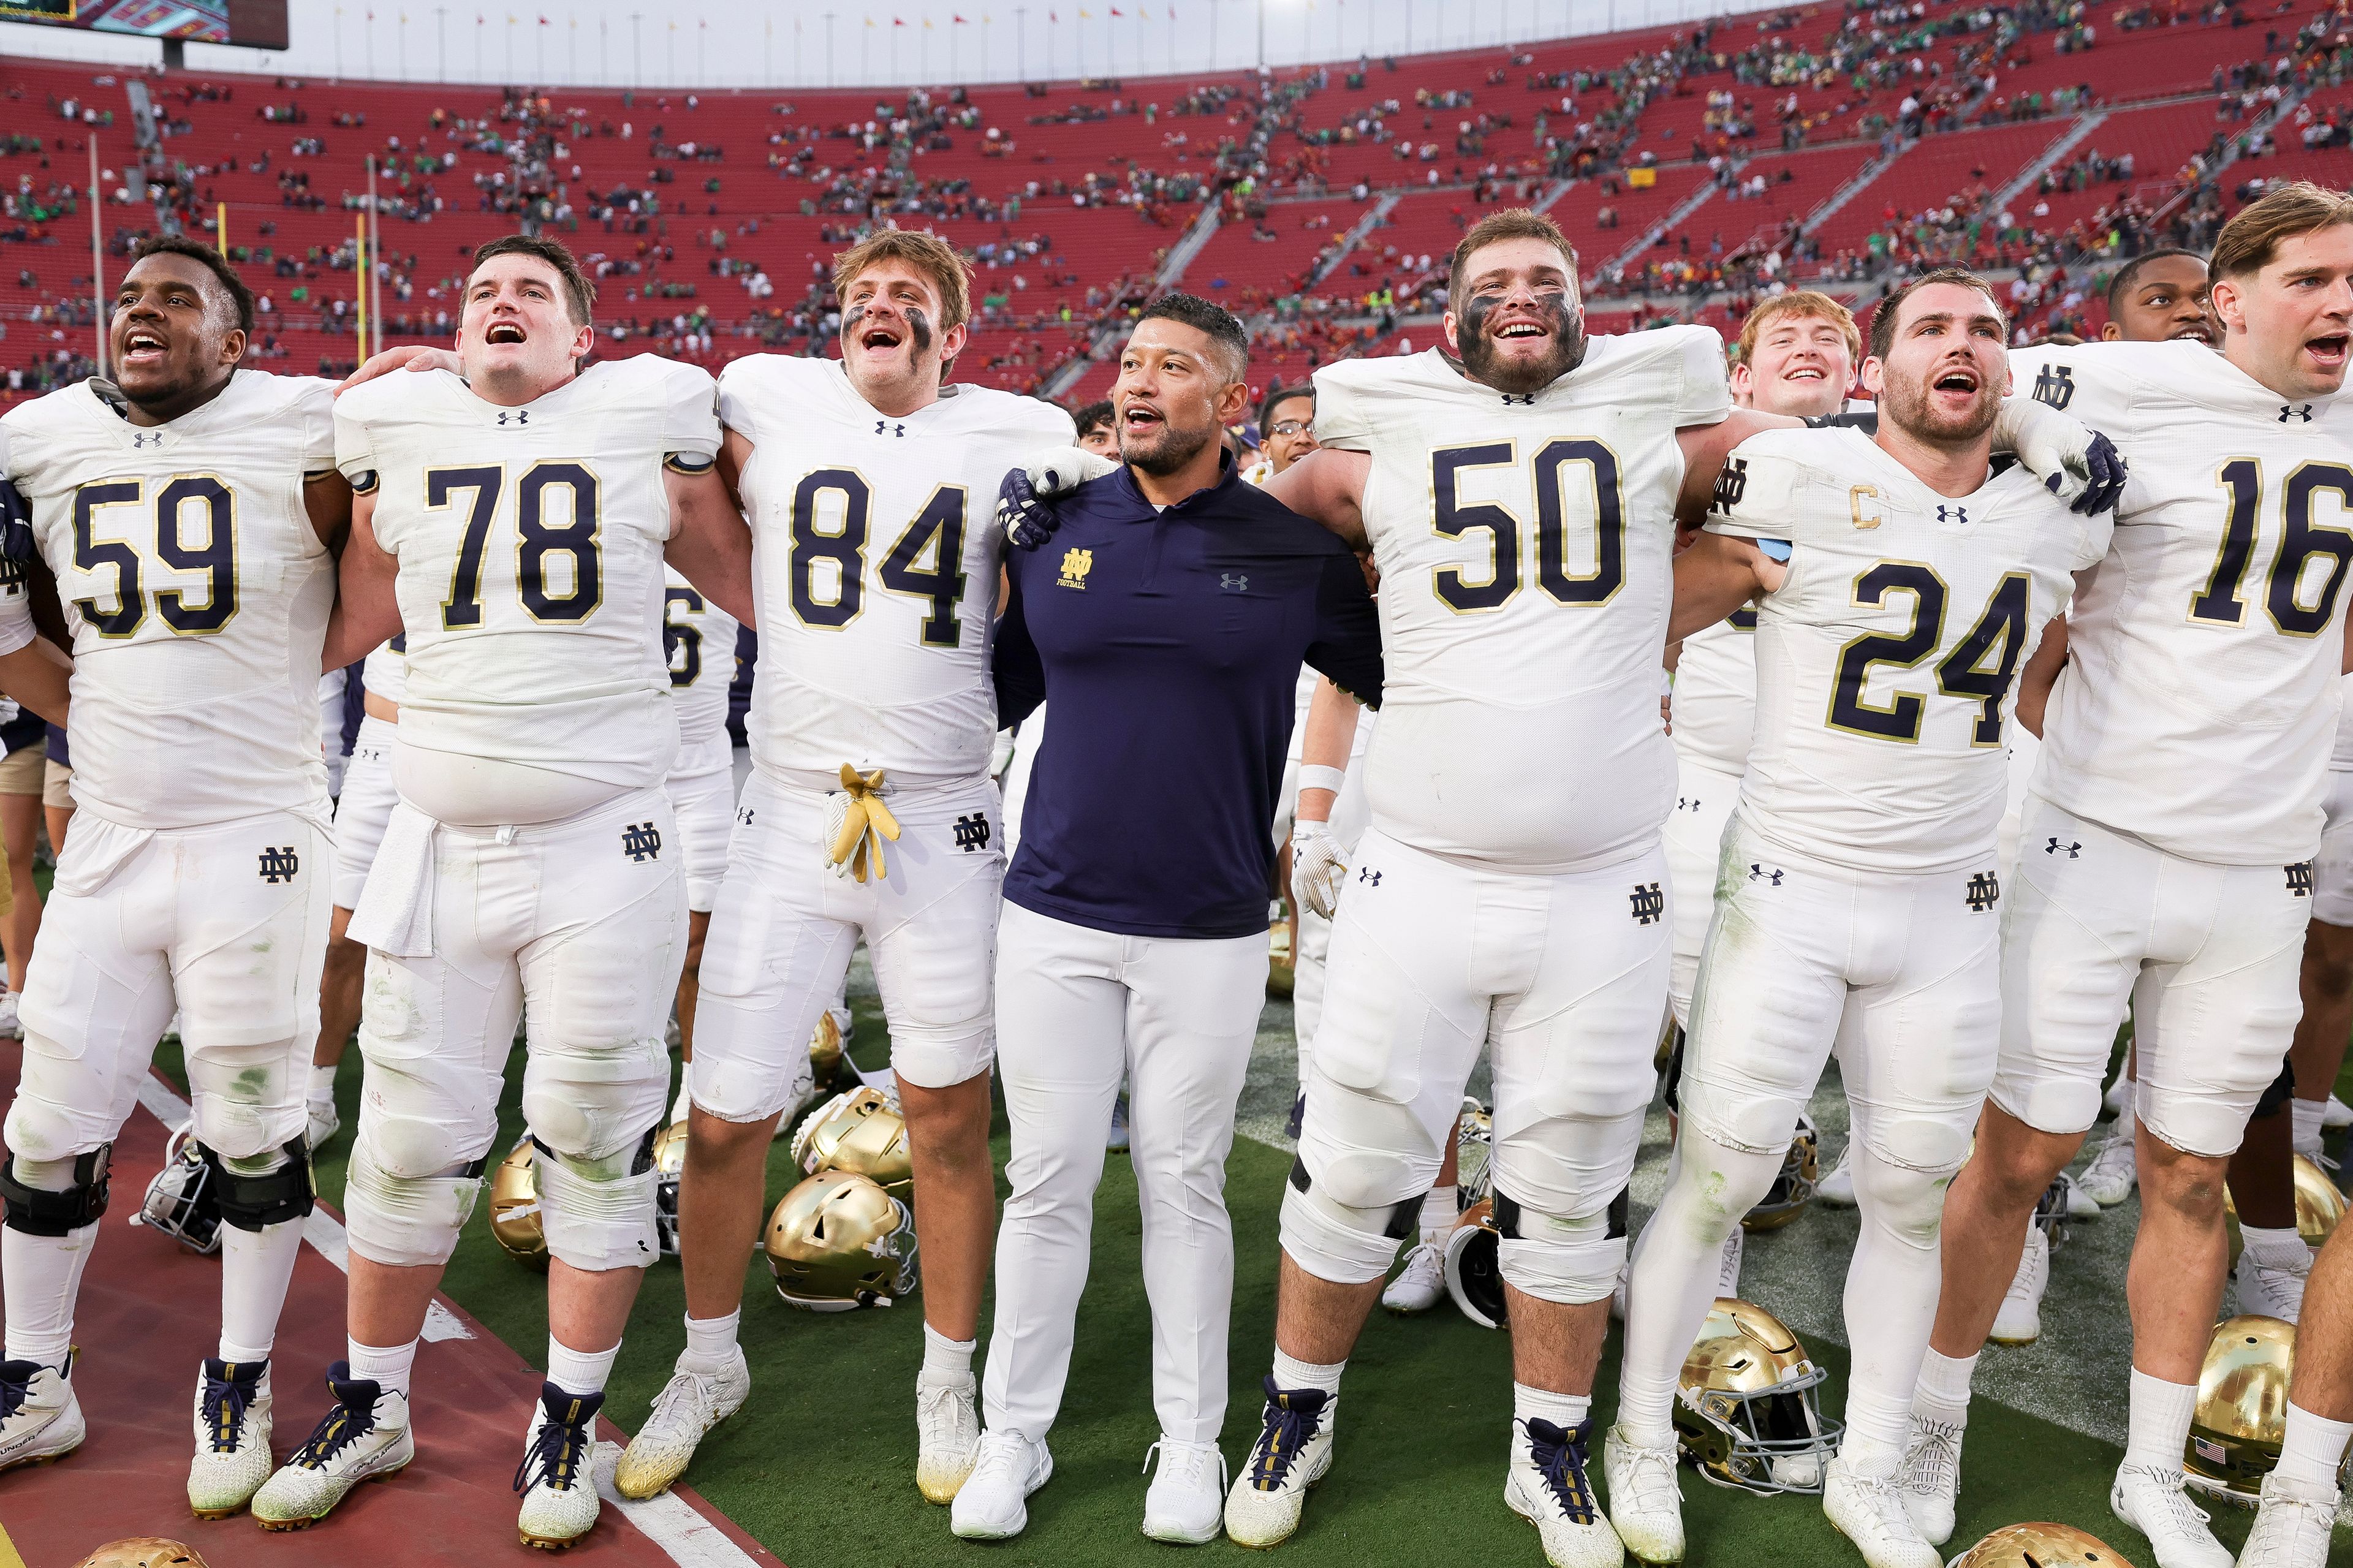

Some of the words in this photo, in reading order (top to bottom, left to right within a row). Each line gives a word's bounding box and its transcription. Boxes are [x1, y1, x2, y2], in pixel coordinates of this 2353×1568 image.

[1427, 435, 1626, 616] 50
[1849, 484, 1881, 530] C
[72, 472, 240, 639] 59
[423, 458, 603, 632] 78
[788, 464, 969, 648] 84
[1060, 547, 1093, 581] ND
[2185, 456, 2353, 639] 16
[1056, 578, 1086, 590] FOOTBALL
[1824, 558, 2031, 749] 24
[620, 822, 662, 863] ND
[952, 811, 990, 853] ND
[257, 846, 299, 885] ND
[1627, 881, 1665, 927] ND
[1965, 869, 1999, 915] ND
[0, 1434, 36, 1456] UNDER
[354, 1455, 380, 1474] UNDER
